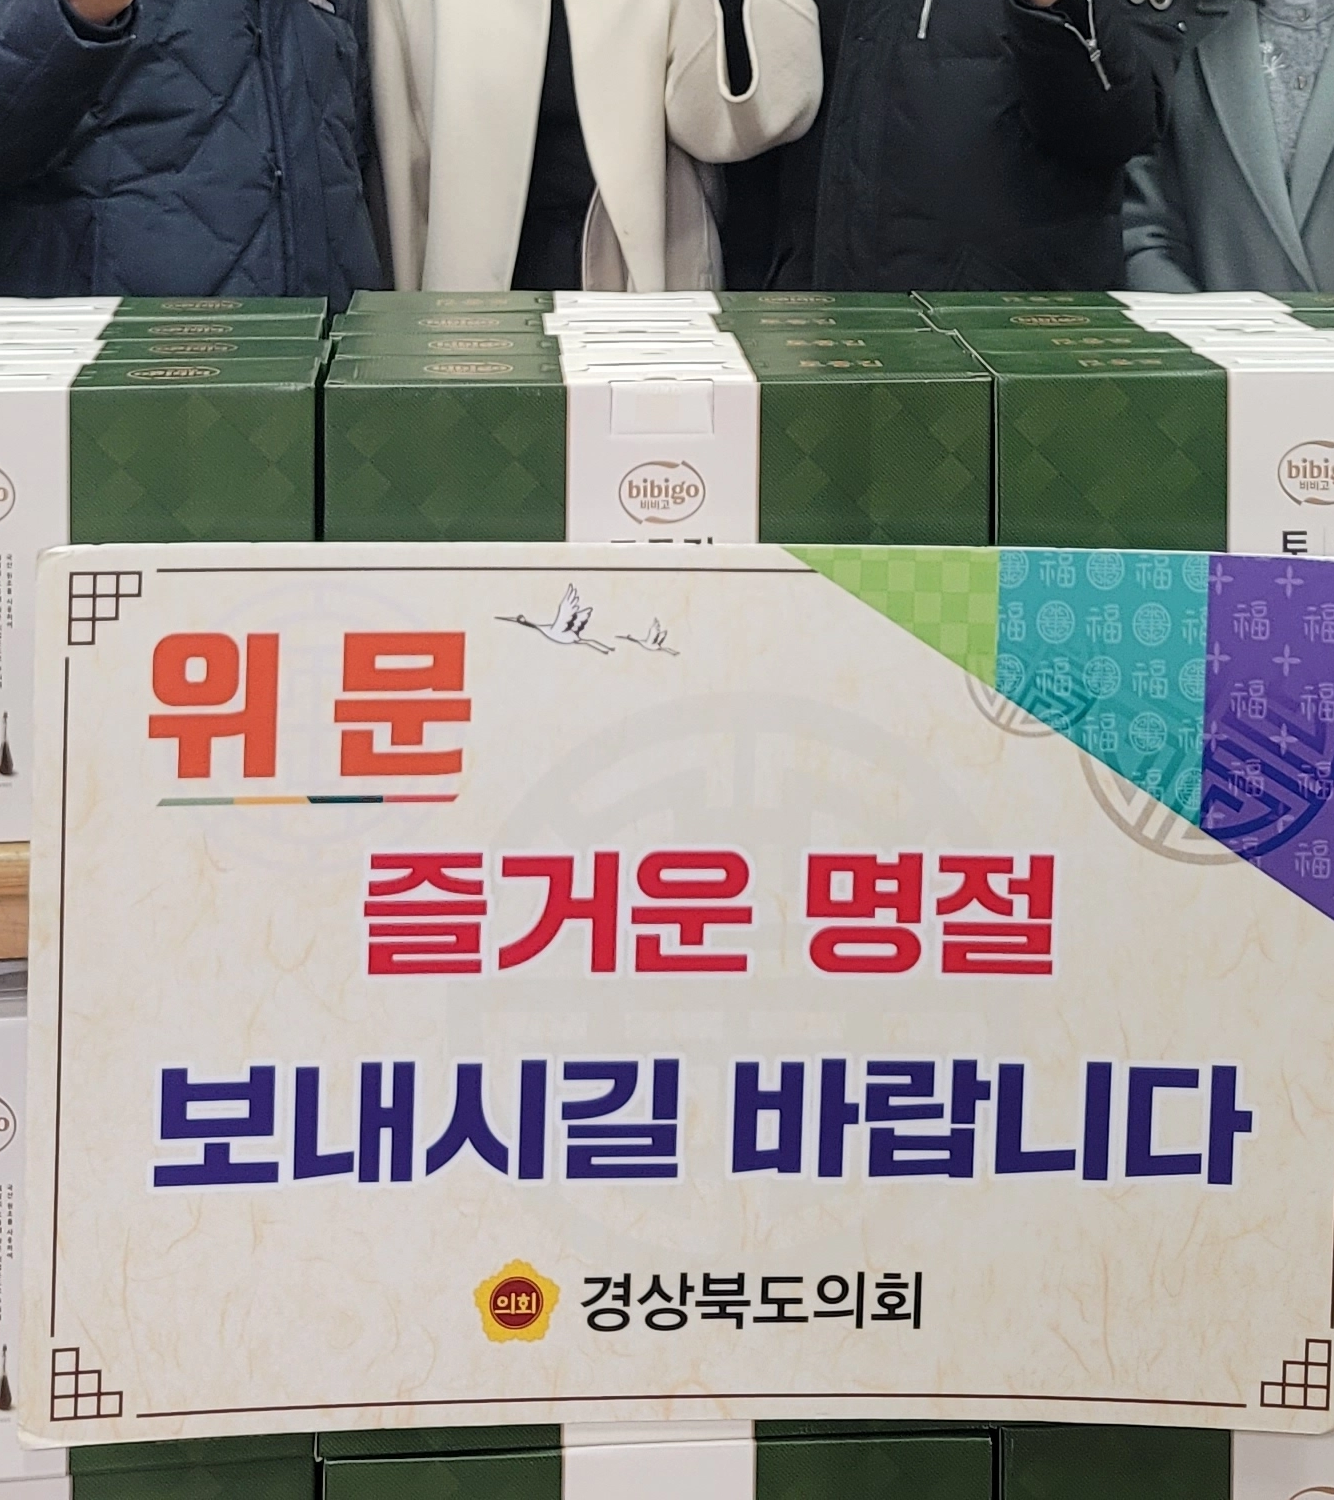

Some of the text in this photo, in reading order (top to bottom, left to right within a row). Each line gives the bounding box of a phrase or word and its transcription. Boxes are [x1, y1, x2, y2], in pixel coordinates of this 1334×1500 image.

[627, 478, 701, 506] bibigo
[640, 499, 671, 510] 비비고
[1299, 479, 1330, 492] 비비고
[146, 631, 473, 779] 위 문
[363, 851, 1057, 976] 즐거운 명절
[152, 1060, 1254, 1188] 보내시길 바랍니다
[493, 1291, 536, 1315] 의회
[580, 1269, 927, 1333] 경상북도의회
